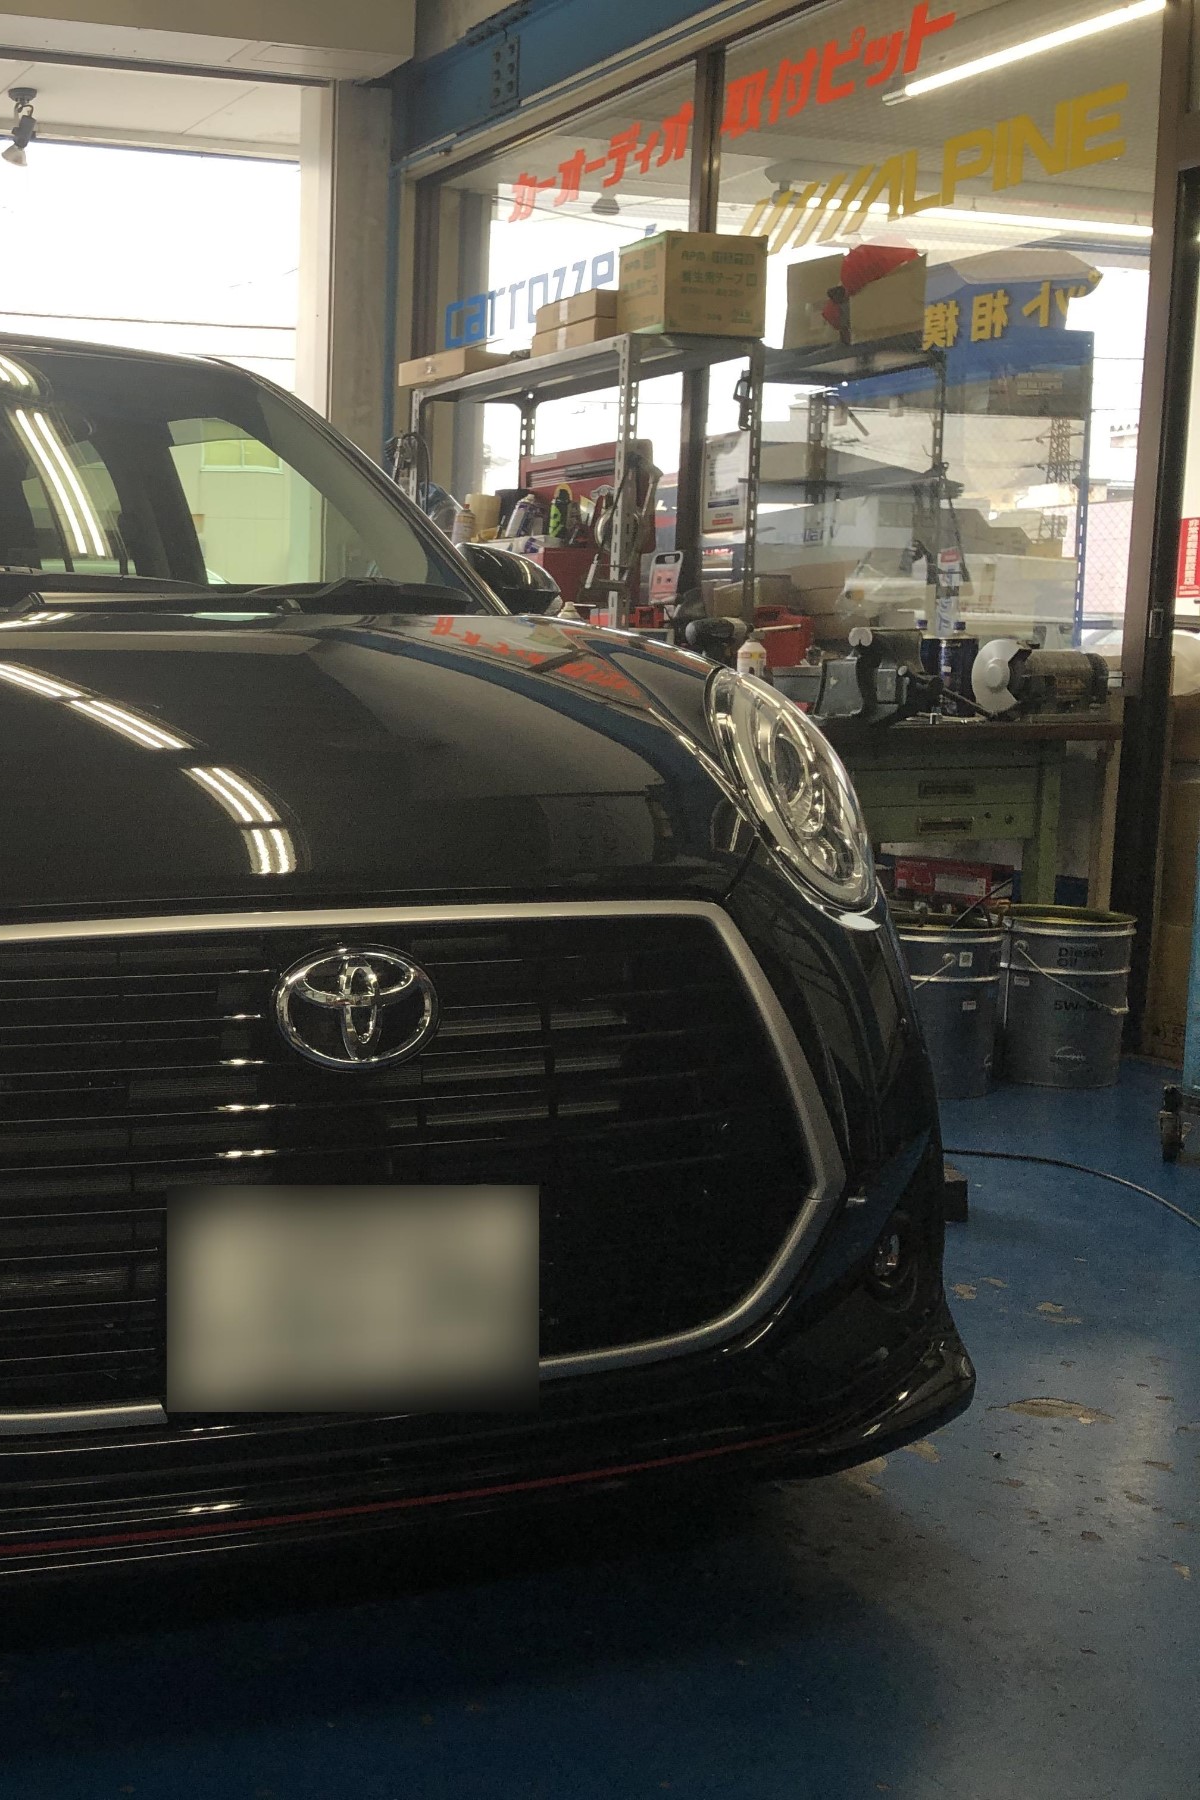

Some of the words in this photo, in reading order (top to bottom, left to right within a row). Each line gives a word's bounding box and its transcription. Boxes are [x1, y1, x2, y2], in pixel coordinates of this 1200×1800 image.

[508, 99, 695, 223] カーオーディオ
[720, 2, 956, 139] 取付ピット
[838, 82, 1129, 235] ALPINE
